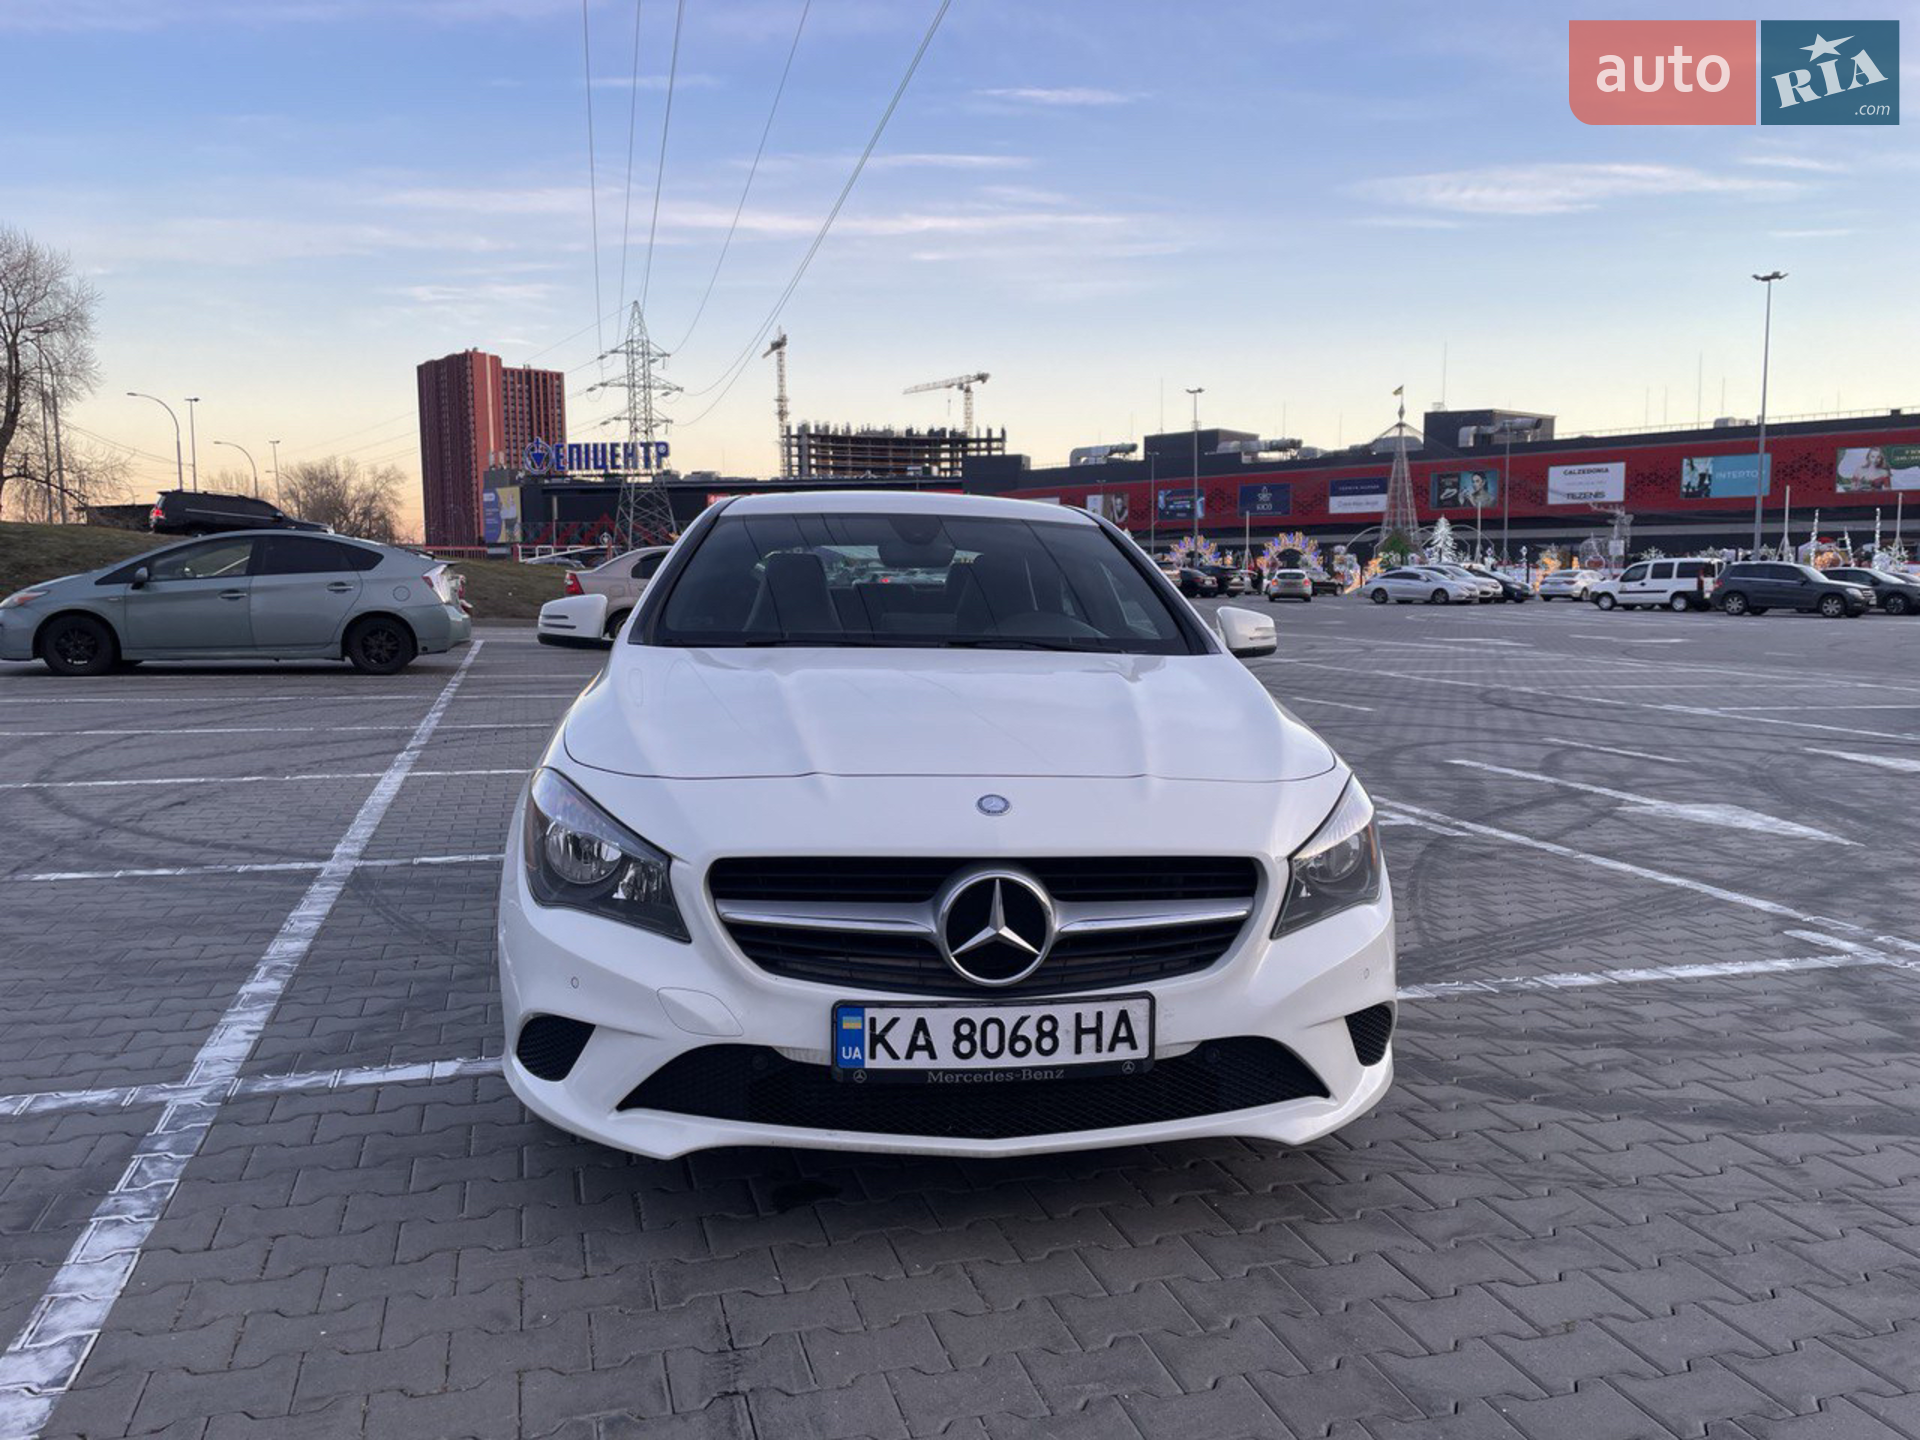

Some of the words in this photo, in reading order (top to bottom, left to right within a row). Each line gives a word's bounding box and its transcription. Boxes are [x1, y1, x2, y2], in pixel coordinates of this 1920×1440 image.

[554, 441, 670, 473] ЕПІЦЕНТР
[1562, 467, 1609, 476] CALZEDONIA
[868, 1016, 938, 1061] KA
[952, 1014, 1060, 1060] 8068
[1074, 1008, 1139, 1055] HA
[841, 1046, 862, 1060] UA
[927, 1067, 1065, 1084] Mercedes-Benz
